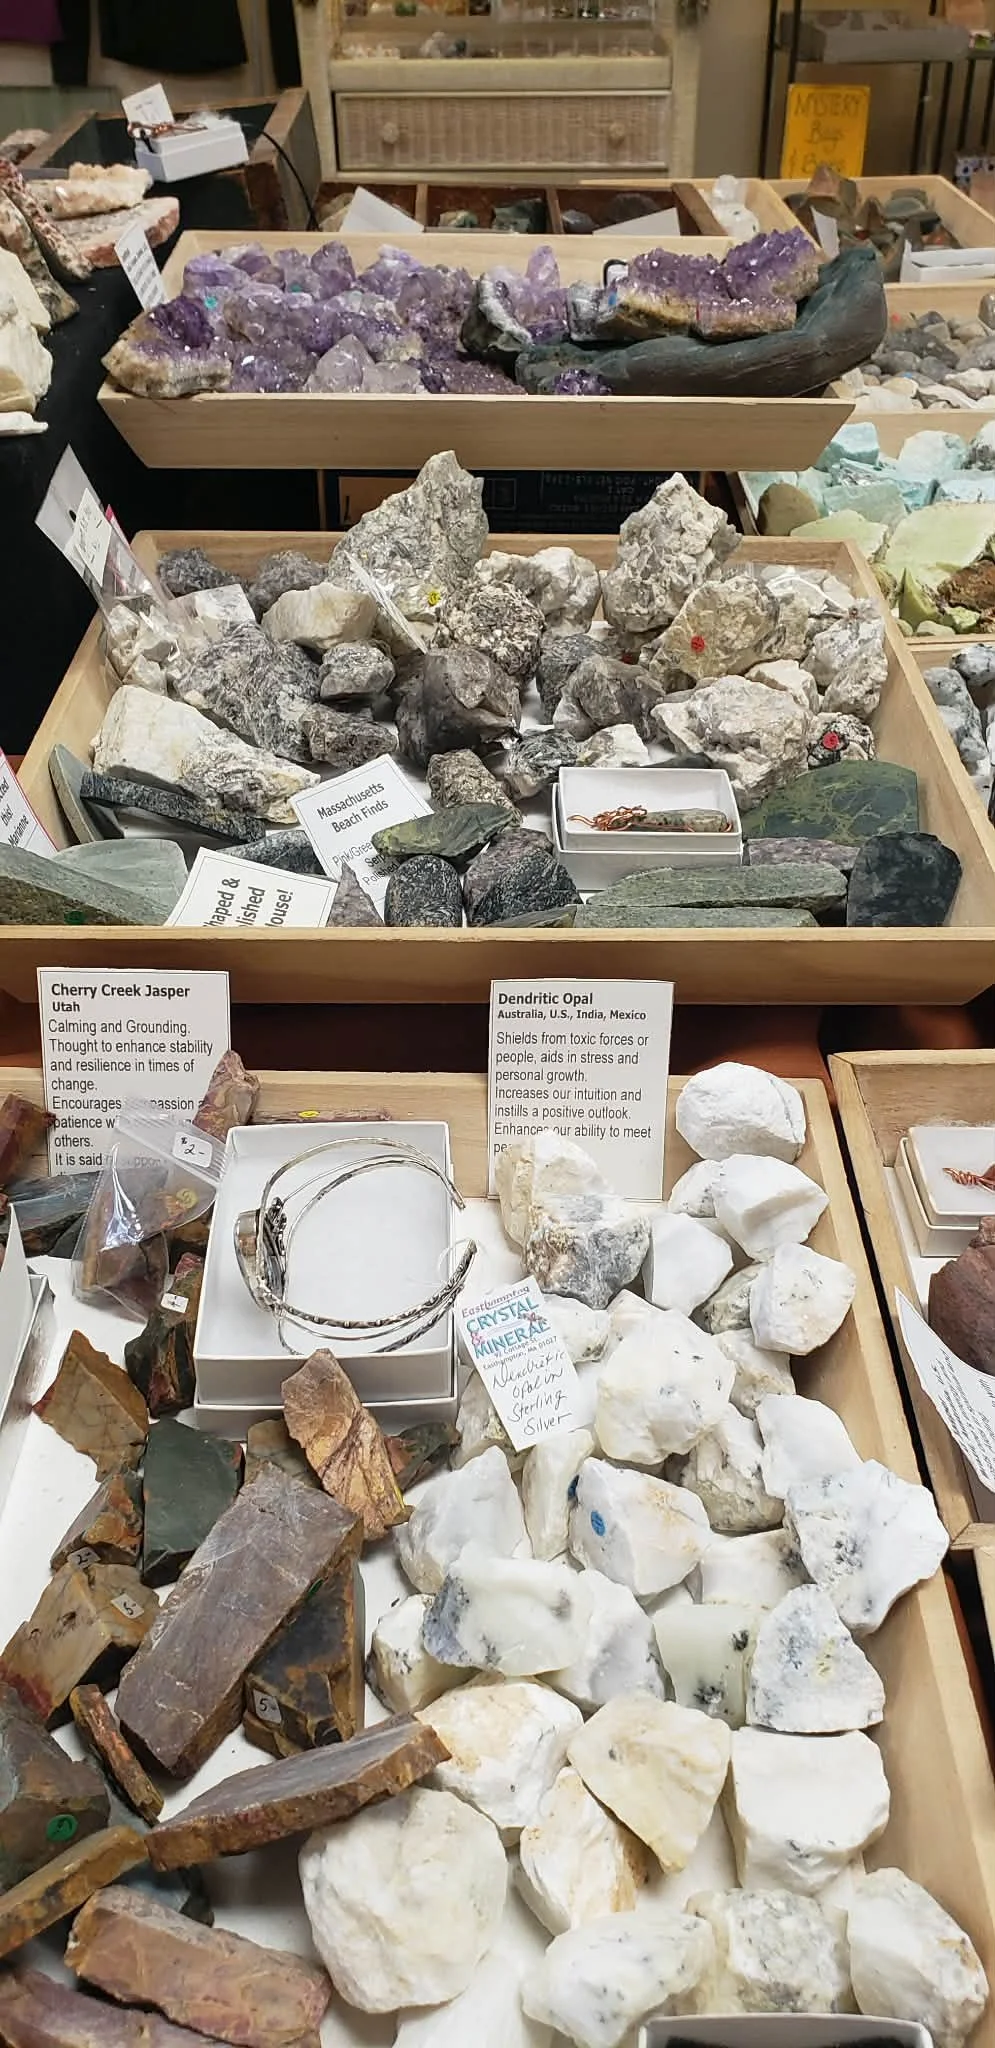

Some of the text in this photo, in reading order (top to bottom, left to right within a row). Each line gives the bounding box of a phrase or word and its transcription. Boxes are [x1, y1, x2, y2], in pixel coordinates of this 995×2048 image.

[795, 92, 861, 117] MYSTERY
[316, 781, 385, 820] Massachusetts
[331, 812, 362, 833] Beach
[361, 799, 389, 820] Finds
[332, 842, 373, 866] Pink/Gree
[364, 854, 387, 868] Serp
[203, 877, 241, 927] haped &
[235, 886, 266, 927] lished
[51, 983, 190, 1000] Cherry Creek Jasper
[498, 992, 593, 1007] Dendritic Opal
[52, 1001, 80, 1012] Utah
[497, 1009, 646, 1021] Australia, U.S., India, Mexico
[48, 1019, 191, 1037] Calming and Grounding.
[496, 1032, 649, 1045] Shields from toxic forces or
[49, 1038, 213, 1056] Thought to enhance stability
[50, 1058, 195, 1072] and resilience in times of
[496, 1051, 639, 1065] people, aids in stress and
[495, 1069, 588, 1084] personal growth.
[51, 1077, 98, 1093] change.
[495, 1086, 642, 1101] Increases our intuition and
[52, 1096, 121, 1112] Encourages
[494, 1104, 631, 1120] instills a positive outlook.
[53, 1115, 103, 1131] patience
[494, 1122, 652, 1140] Enhance our ability to meet
[54, 1134, 93, 1147] others.
[55, 1153, 63, 1165] It
[66, 1153, 75, 1166] is
[79, 1153, 103, 1165] said
[466, 1296, 540, 1334] CRYSTAL
[473, 1320, 551, 1359] MINERAL
[507, 1390, 568, 1423] Sterling
[523, 1412, 573, 1436] Silver
